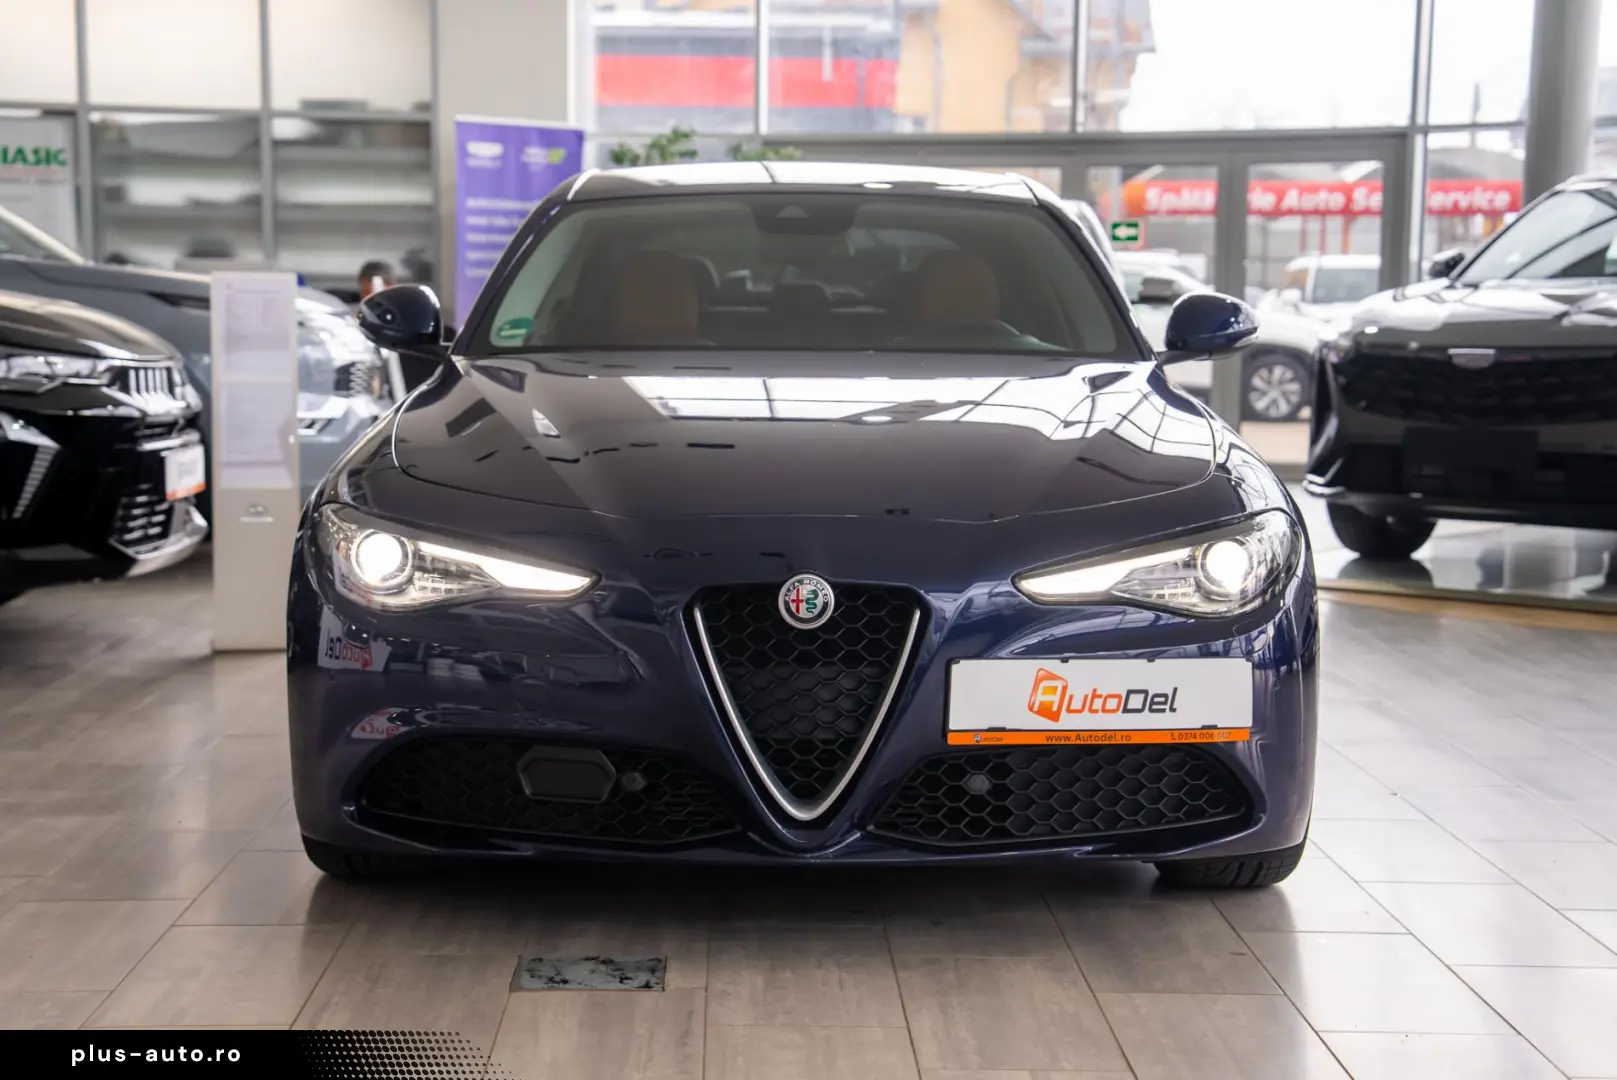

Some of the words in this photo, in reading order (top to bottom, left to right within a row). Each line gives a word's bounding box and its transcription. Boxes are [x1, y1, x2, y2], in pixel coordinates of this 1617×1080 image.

[1280, 187, 1345, 211] Auto
[1428, 185, 1511, 210] ervice
[784, 582, 800, 601] ALFA
[803, 579, 829, 602] ROMEO
[1028, 667, 1178, 724] AutoDel
[1045, 732, 1132, 743] www.Autodel.ro
[1178, 731, 1197, 740] 0374
